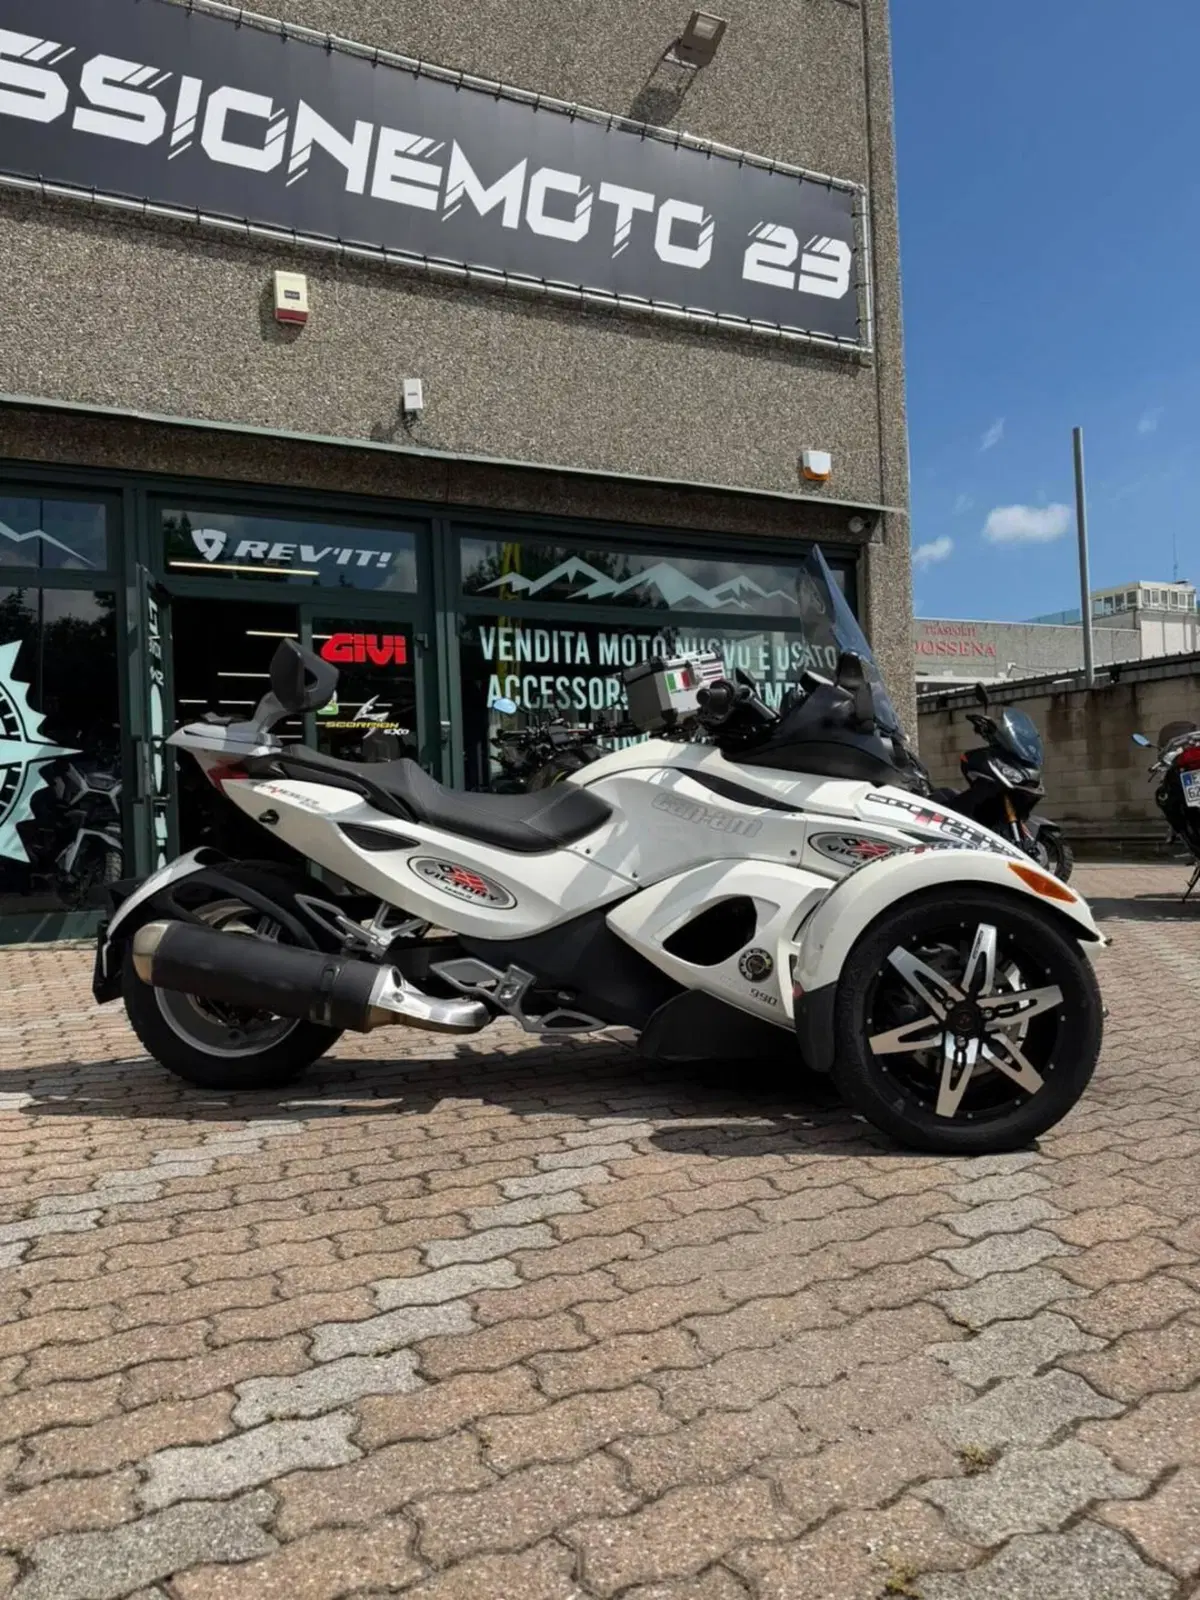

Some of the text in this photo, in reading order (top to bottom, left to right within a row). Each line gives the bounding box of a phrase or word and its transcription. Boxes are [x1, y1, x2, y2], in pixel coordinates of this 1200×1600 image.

[742, 220, 852, 300] 23
[234, 540, 392, 569] REV'IT!
[320, 632, 407, 665] GIVI
[479, 626, 591, 665] VENDITA
[600, 633, 667, 666] MOTO
[758, 641, 771, 671] E
[777, 640, 837, 672] USATO
[324, 721, 400, 729] SCORPION
[424, 867, 499, 902] VICTORY
